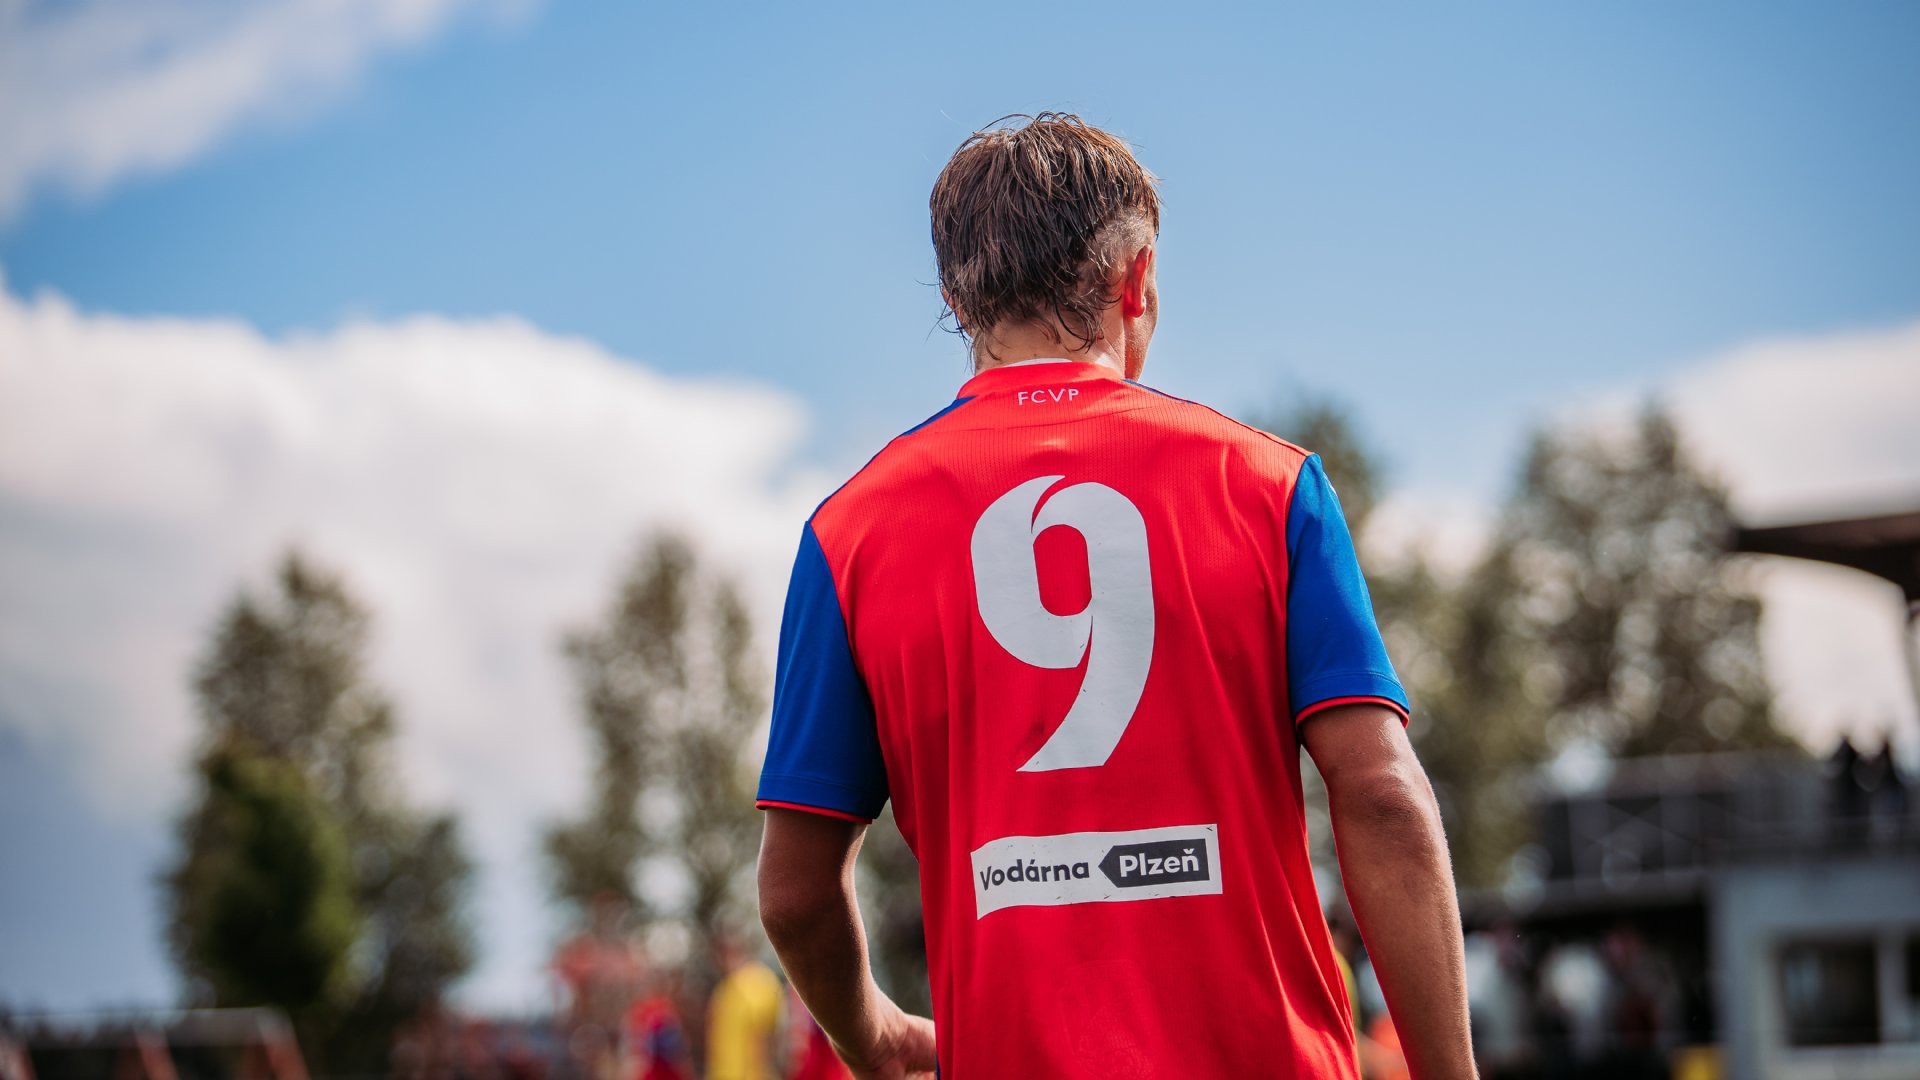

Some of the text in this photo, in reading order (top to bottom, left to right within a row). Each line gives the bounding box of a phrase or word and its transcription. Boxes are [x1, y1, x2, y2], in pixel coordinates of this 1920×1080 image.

[1017, 388, 1080, 406] FCVP
[970, 474, 1156, 773] 9
[979, 848, 1200, 891] Vodárna Plzeň
